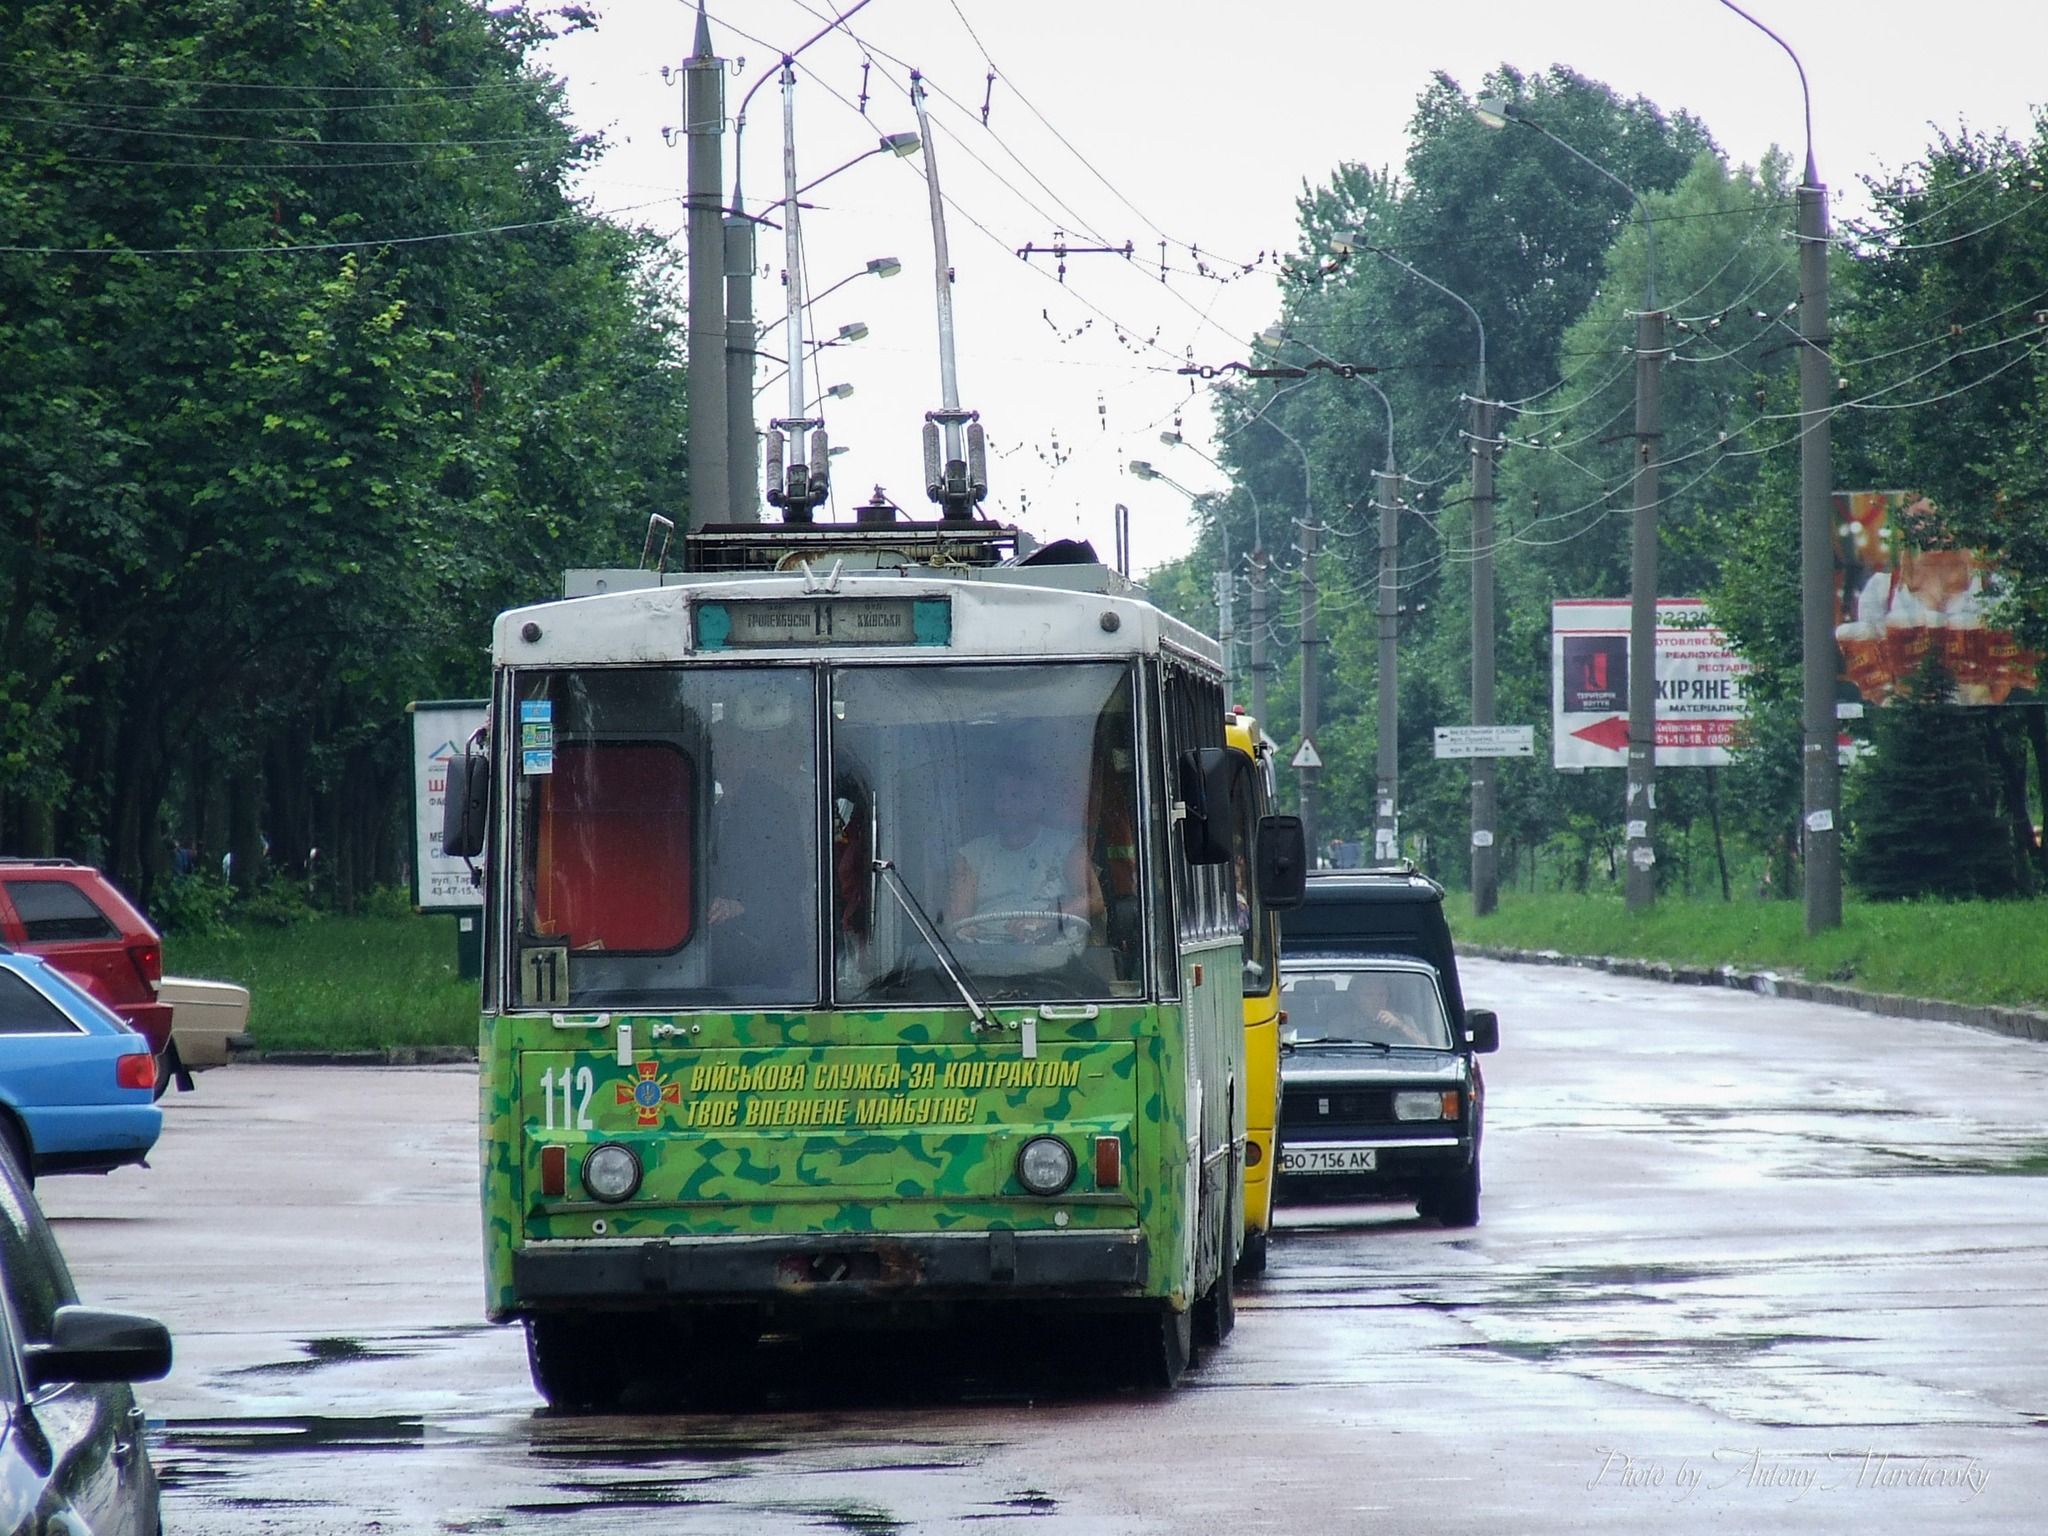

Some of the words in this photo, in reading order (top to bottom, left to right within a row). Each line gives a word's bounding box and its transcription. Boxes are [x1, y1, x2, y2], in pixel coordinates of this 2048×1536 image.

[814, 602, 832, 635] 11
[531, 953, 556, 1002] 11
[690, 1062, 805, 1092] ВІЙСЬКОВА
[813, 1064, 900, 1090] СЛУЖБА
[908, 1062, 936, 1089] ЗА
[943, 1061, 1081, 1088] КОНТРАКТОМ
[540, 1066, 593, 1130] 112
[687, 1101, 737, 1126] ТВОЄ
[745, 1099, 849, 1126] ВПЕВНЕНЕ
[855, 1094, 977, 1124] МАЙБУТНЄ!
[1310, 1153, 1345, 1168] 7156
[1350, 1152, 1371, 1167] AK
